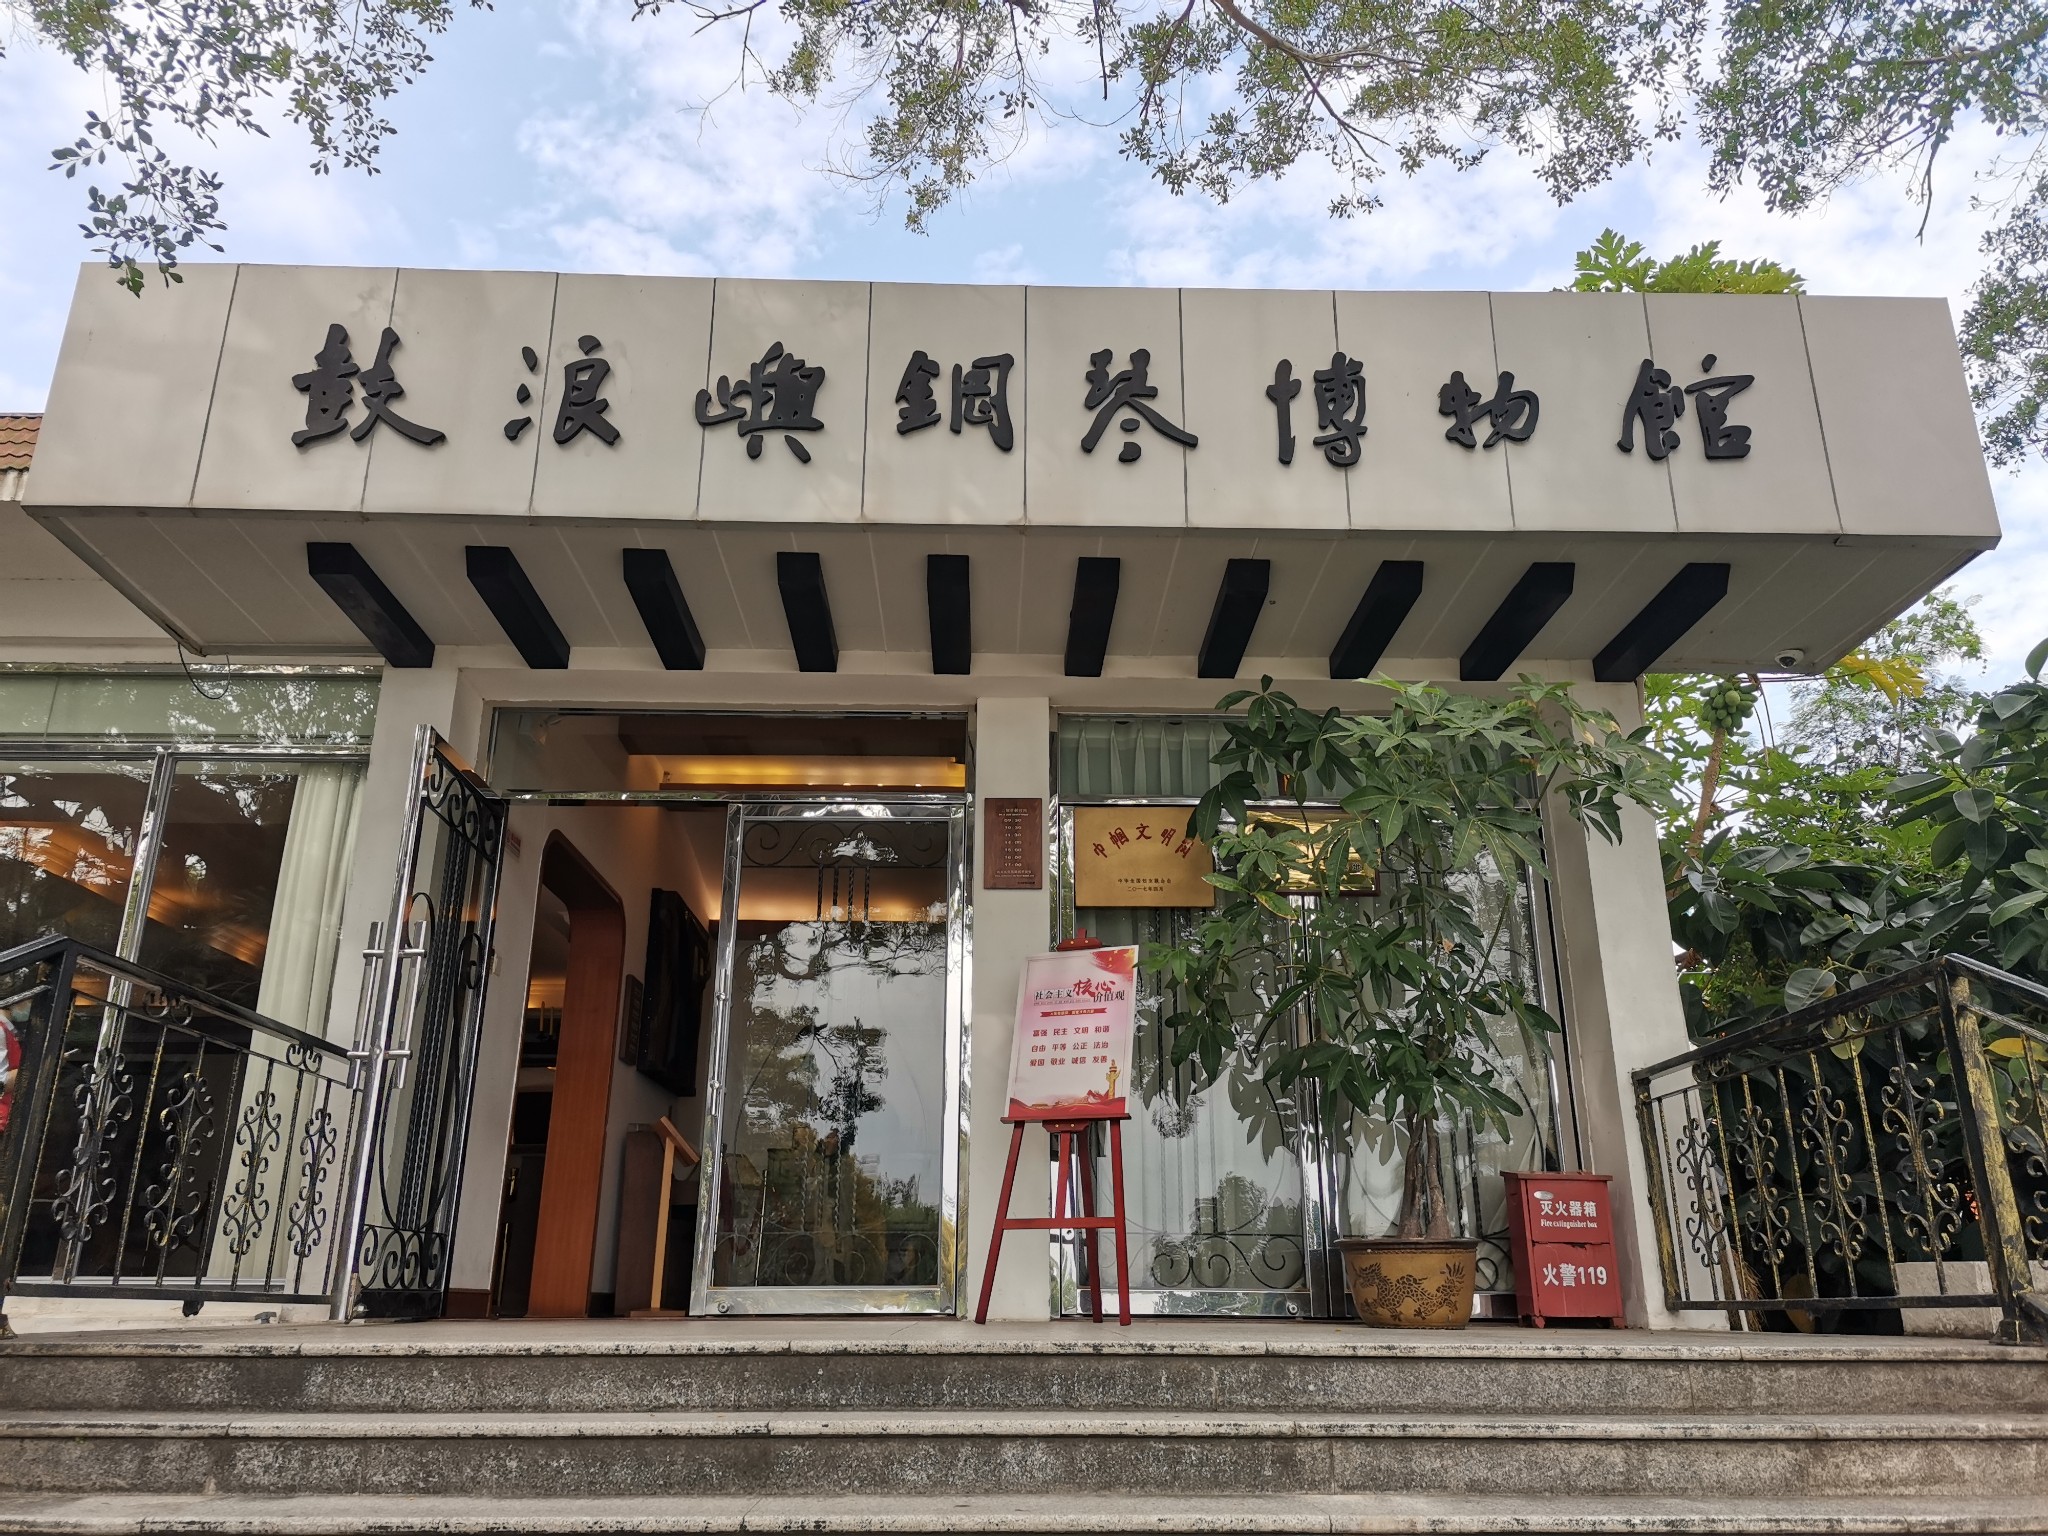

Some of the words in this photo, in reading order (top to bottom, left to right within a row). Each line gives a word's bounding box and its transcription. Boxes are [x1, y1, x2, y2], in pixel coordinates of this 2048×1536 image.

[1073, 978, 1116, 997] 核心
[1035, 989, 1073, 1000] 社会主义
[1093, 989, 1125, 1002] 价值观
[1032, 1029, 1048, 1037] 富强
[1053, 1028, 1068, 1036] 民主
[1073, 1026, 1089, 1035] 文明
[1094, 1025, 1110, 1034] 和谐
[1031, 1044, 1046, 1053] 自由
[1052, 1043, 1067, 1051] 平等
[1072, 1042, 1088, 1050] 公正
[1093, 1040, 1109, 1049] 法治
[1029, 1058, 1045, 1067] 爱国
[1050, 1057, 1066, 1066] 敬业
[1071, 1056, 1087, 1065] 诚信
[1540, 1200, 1597, 1217] 灭火器箱
[1540, 1219, 1553, 1227] Fire
[1553, 1220, 1587, 1229] extinguisher
[1587, 1220, 1598, 1228] box
[1542, 1263, 1607, 1287] 火警119
